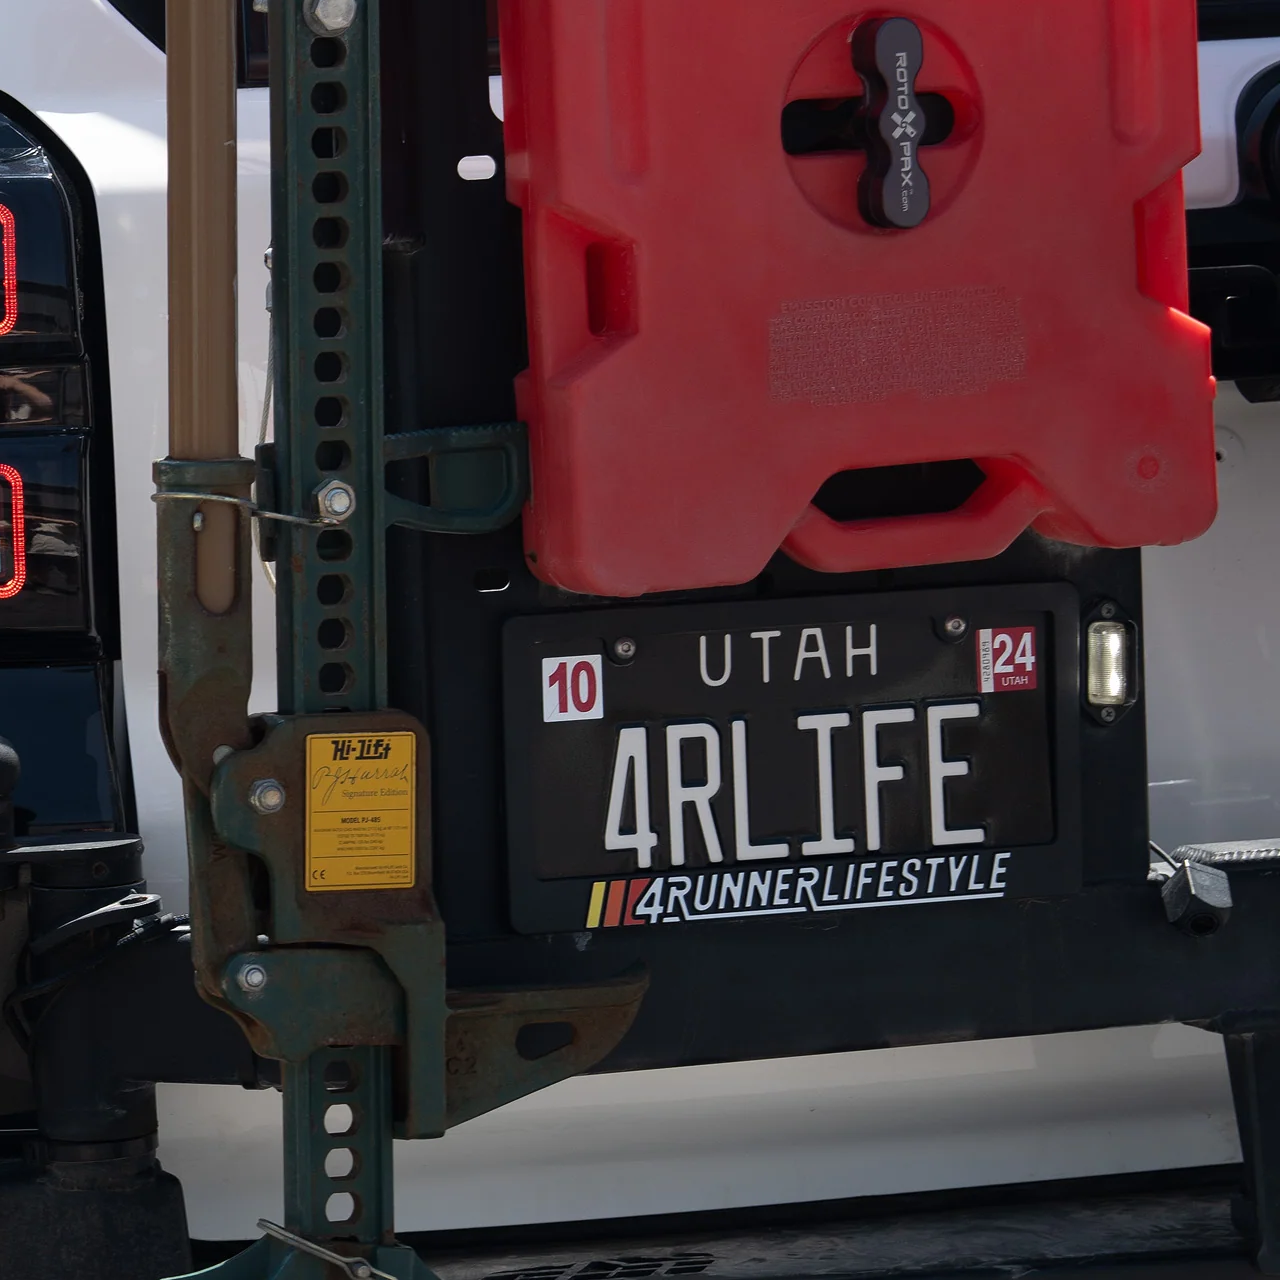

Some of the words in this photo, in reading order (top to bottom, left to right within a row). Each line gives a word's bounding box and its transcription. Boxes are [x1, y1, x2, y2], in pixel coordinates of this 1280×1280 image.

[895, 51, 909, 111] ROTO
[699, 622, 879, 687] UTAH
[992, 631, 1036, 674] 24
[548, 659, 597, 715] 10
[1001, 675, 1029, 687] UTAH
[330, 738, 392, 761] Hi-Lift
[341, 788, 379, 800] Signature
[380, 786, 409, 796] Edition
[604, 702, 986, 869] 4RLIFE
